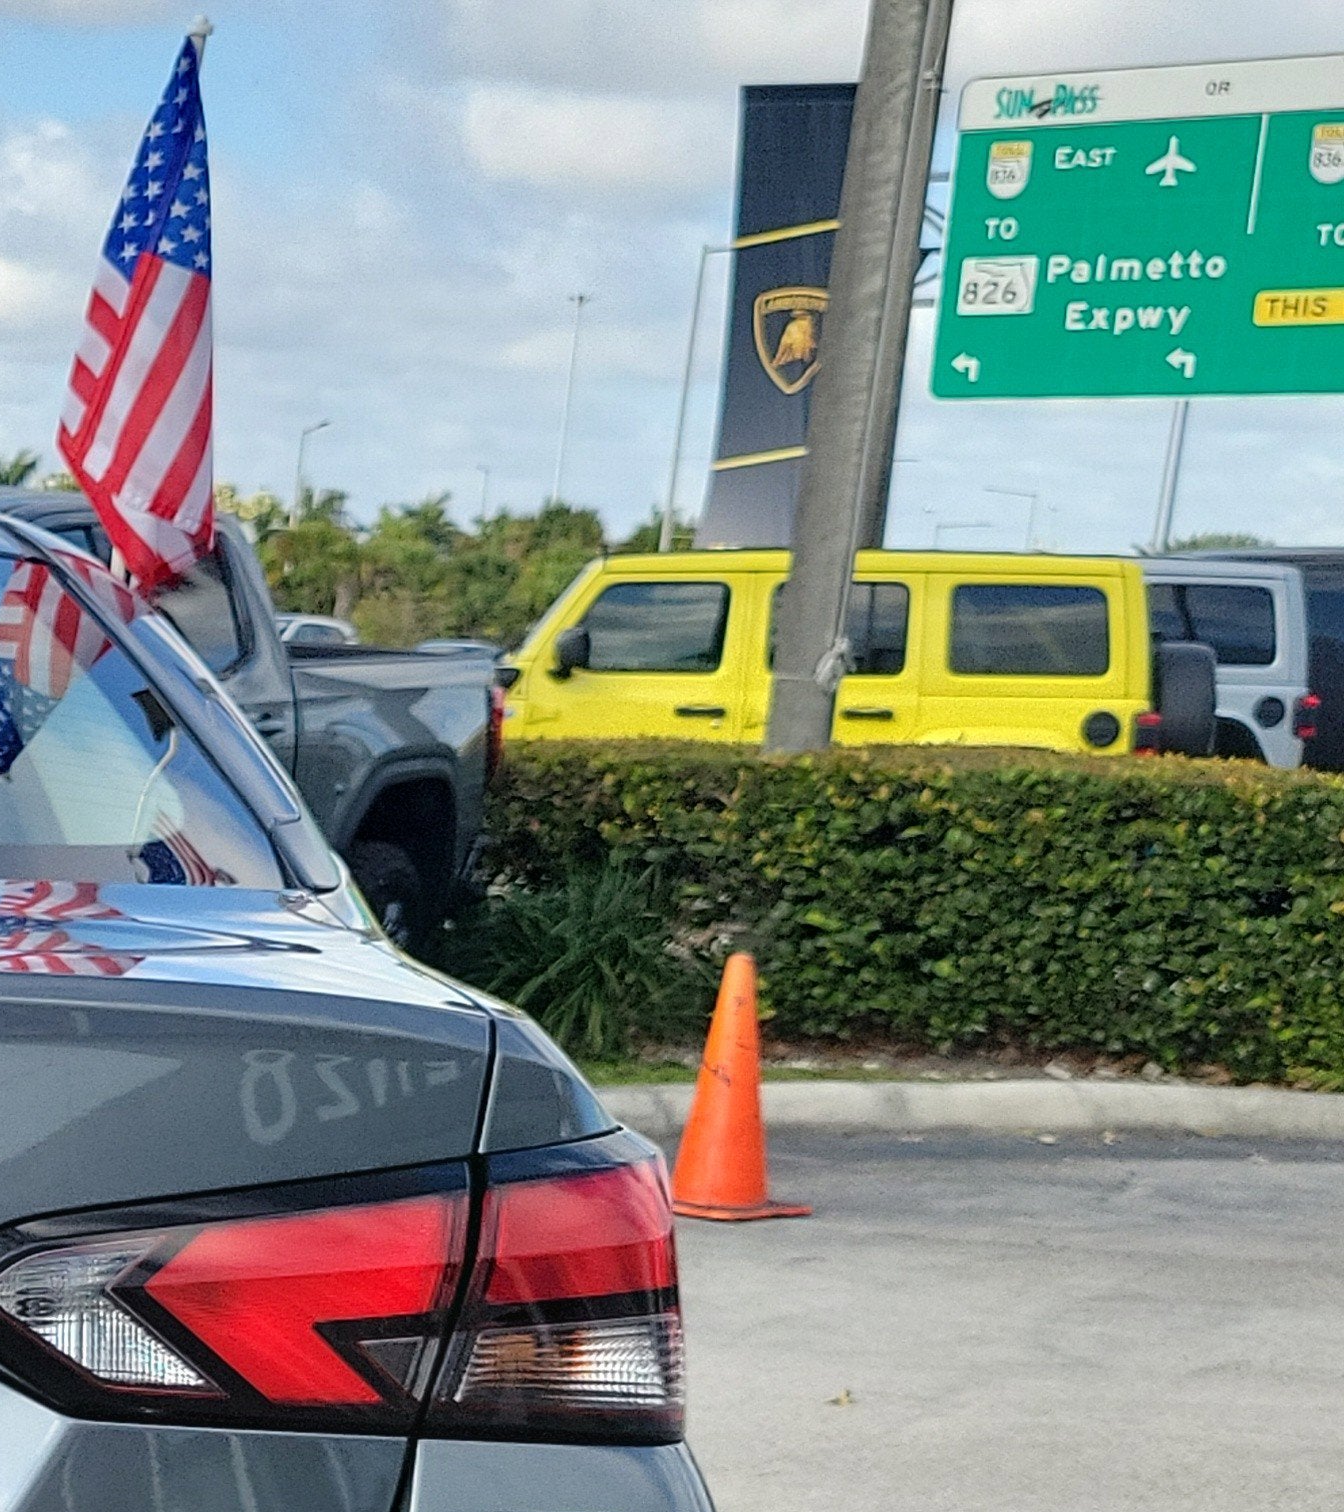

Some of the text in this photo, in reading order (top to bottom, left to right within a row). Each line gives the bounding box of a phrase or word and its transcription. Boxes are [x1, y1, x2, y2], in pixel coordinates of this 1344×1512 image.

[1205, 81, 1231, 96] OR
[1054, 147, 1117, 169] EAST
[985, 217, 1019, 240] TO
[1046, 250, 1228, 284] Palmetto
[962, 281, 1018, 305] 826
[1065, 301, 1191, 335] Expwy
[1265, 296, 1329, 317] THIS
